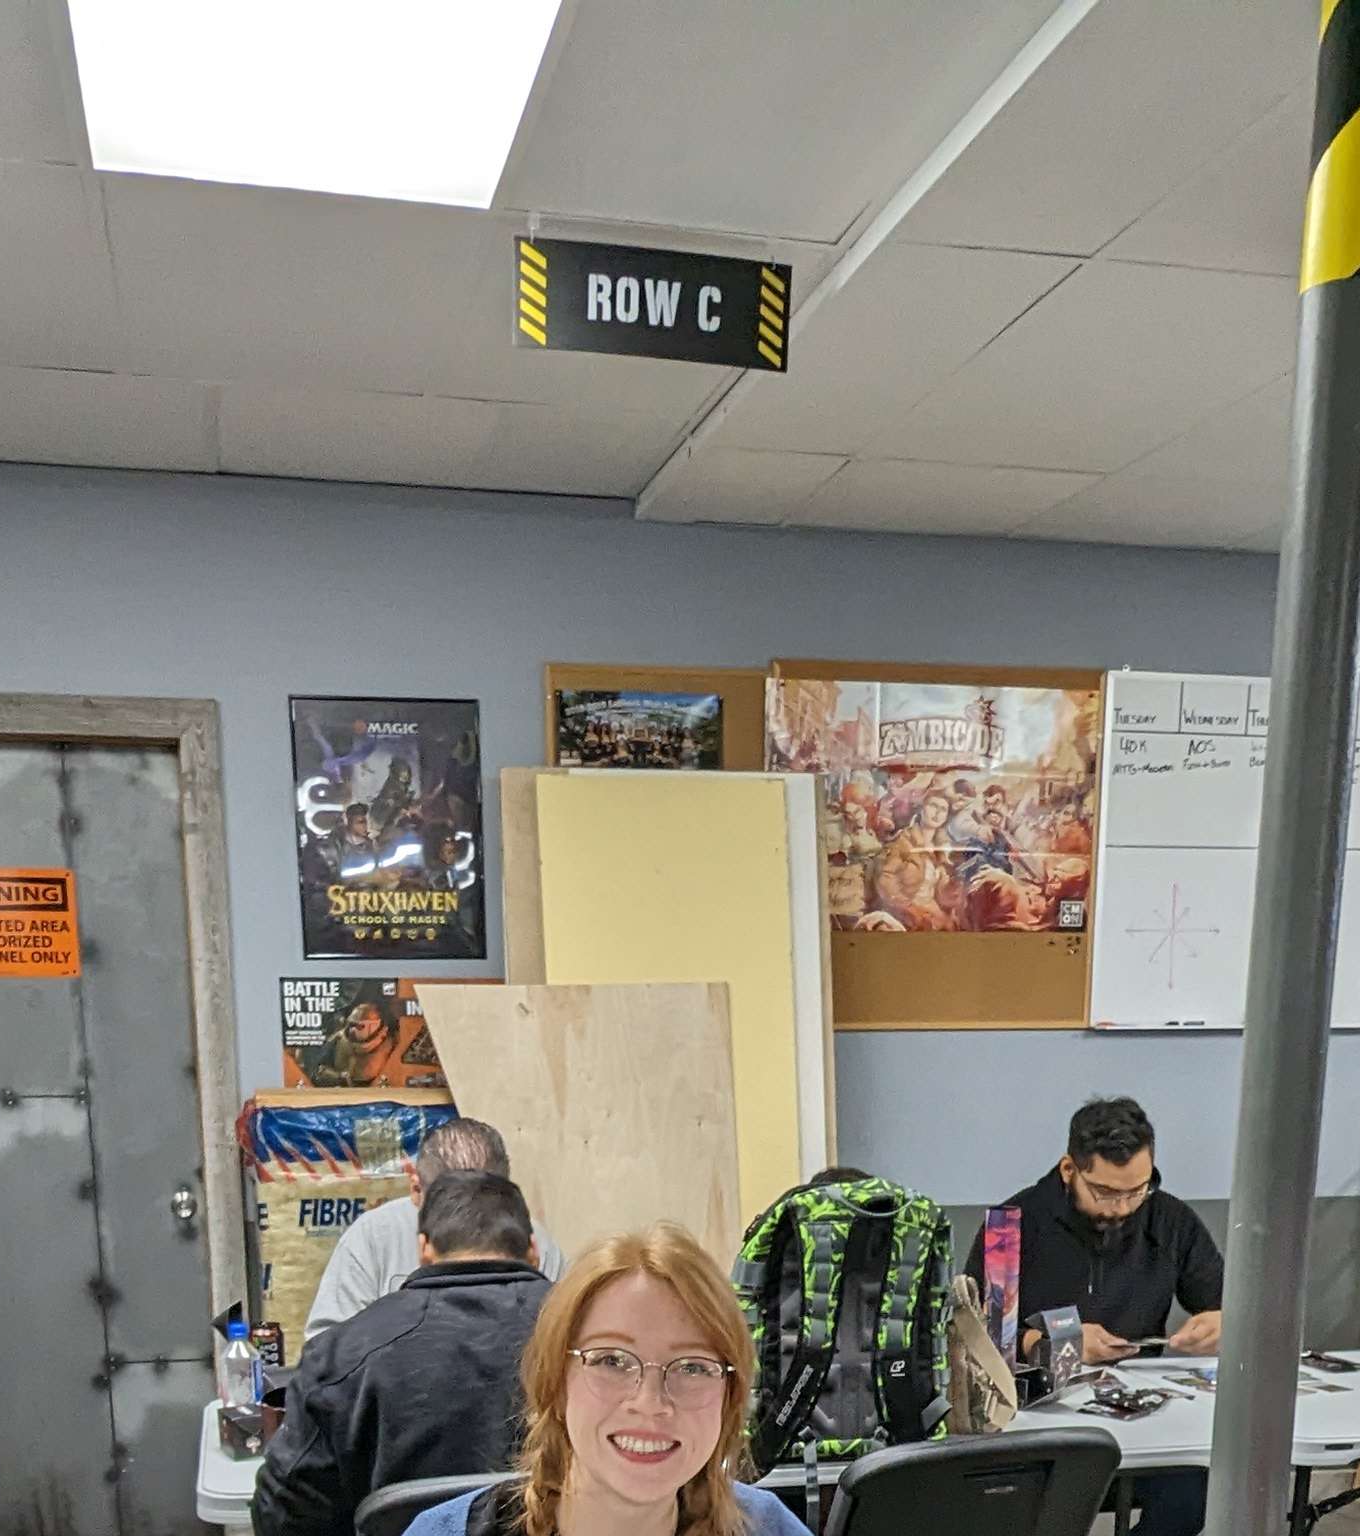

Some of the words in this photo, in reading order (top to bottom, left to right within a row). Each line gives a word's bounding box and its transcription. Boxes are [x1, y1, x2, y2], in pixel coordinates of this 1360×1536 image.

[588, 272, 682, 327] ROW
[698, 285, 722, 333] C
[367, 722, 419, 734] MAGIC
[327, 884, 459, 915] STRIXHAVEN
[28, 919, 71, 934] AREA
[343, 915, 388, 925] SCHOOL
[391, 915, 405, 925] OF
[31, 951, 72, 965] ONLY
[283, 981, 340, 997] BATTLE
[284, 997, 302, 1012] IN
[306, 997, 336, 1012] THE
[285, 1012, 323, 1028] VOID
[298, 1197, 367, 1228] FIBRE
